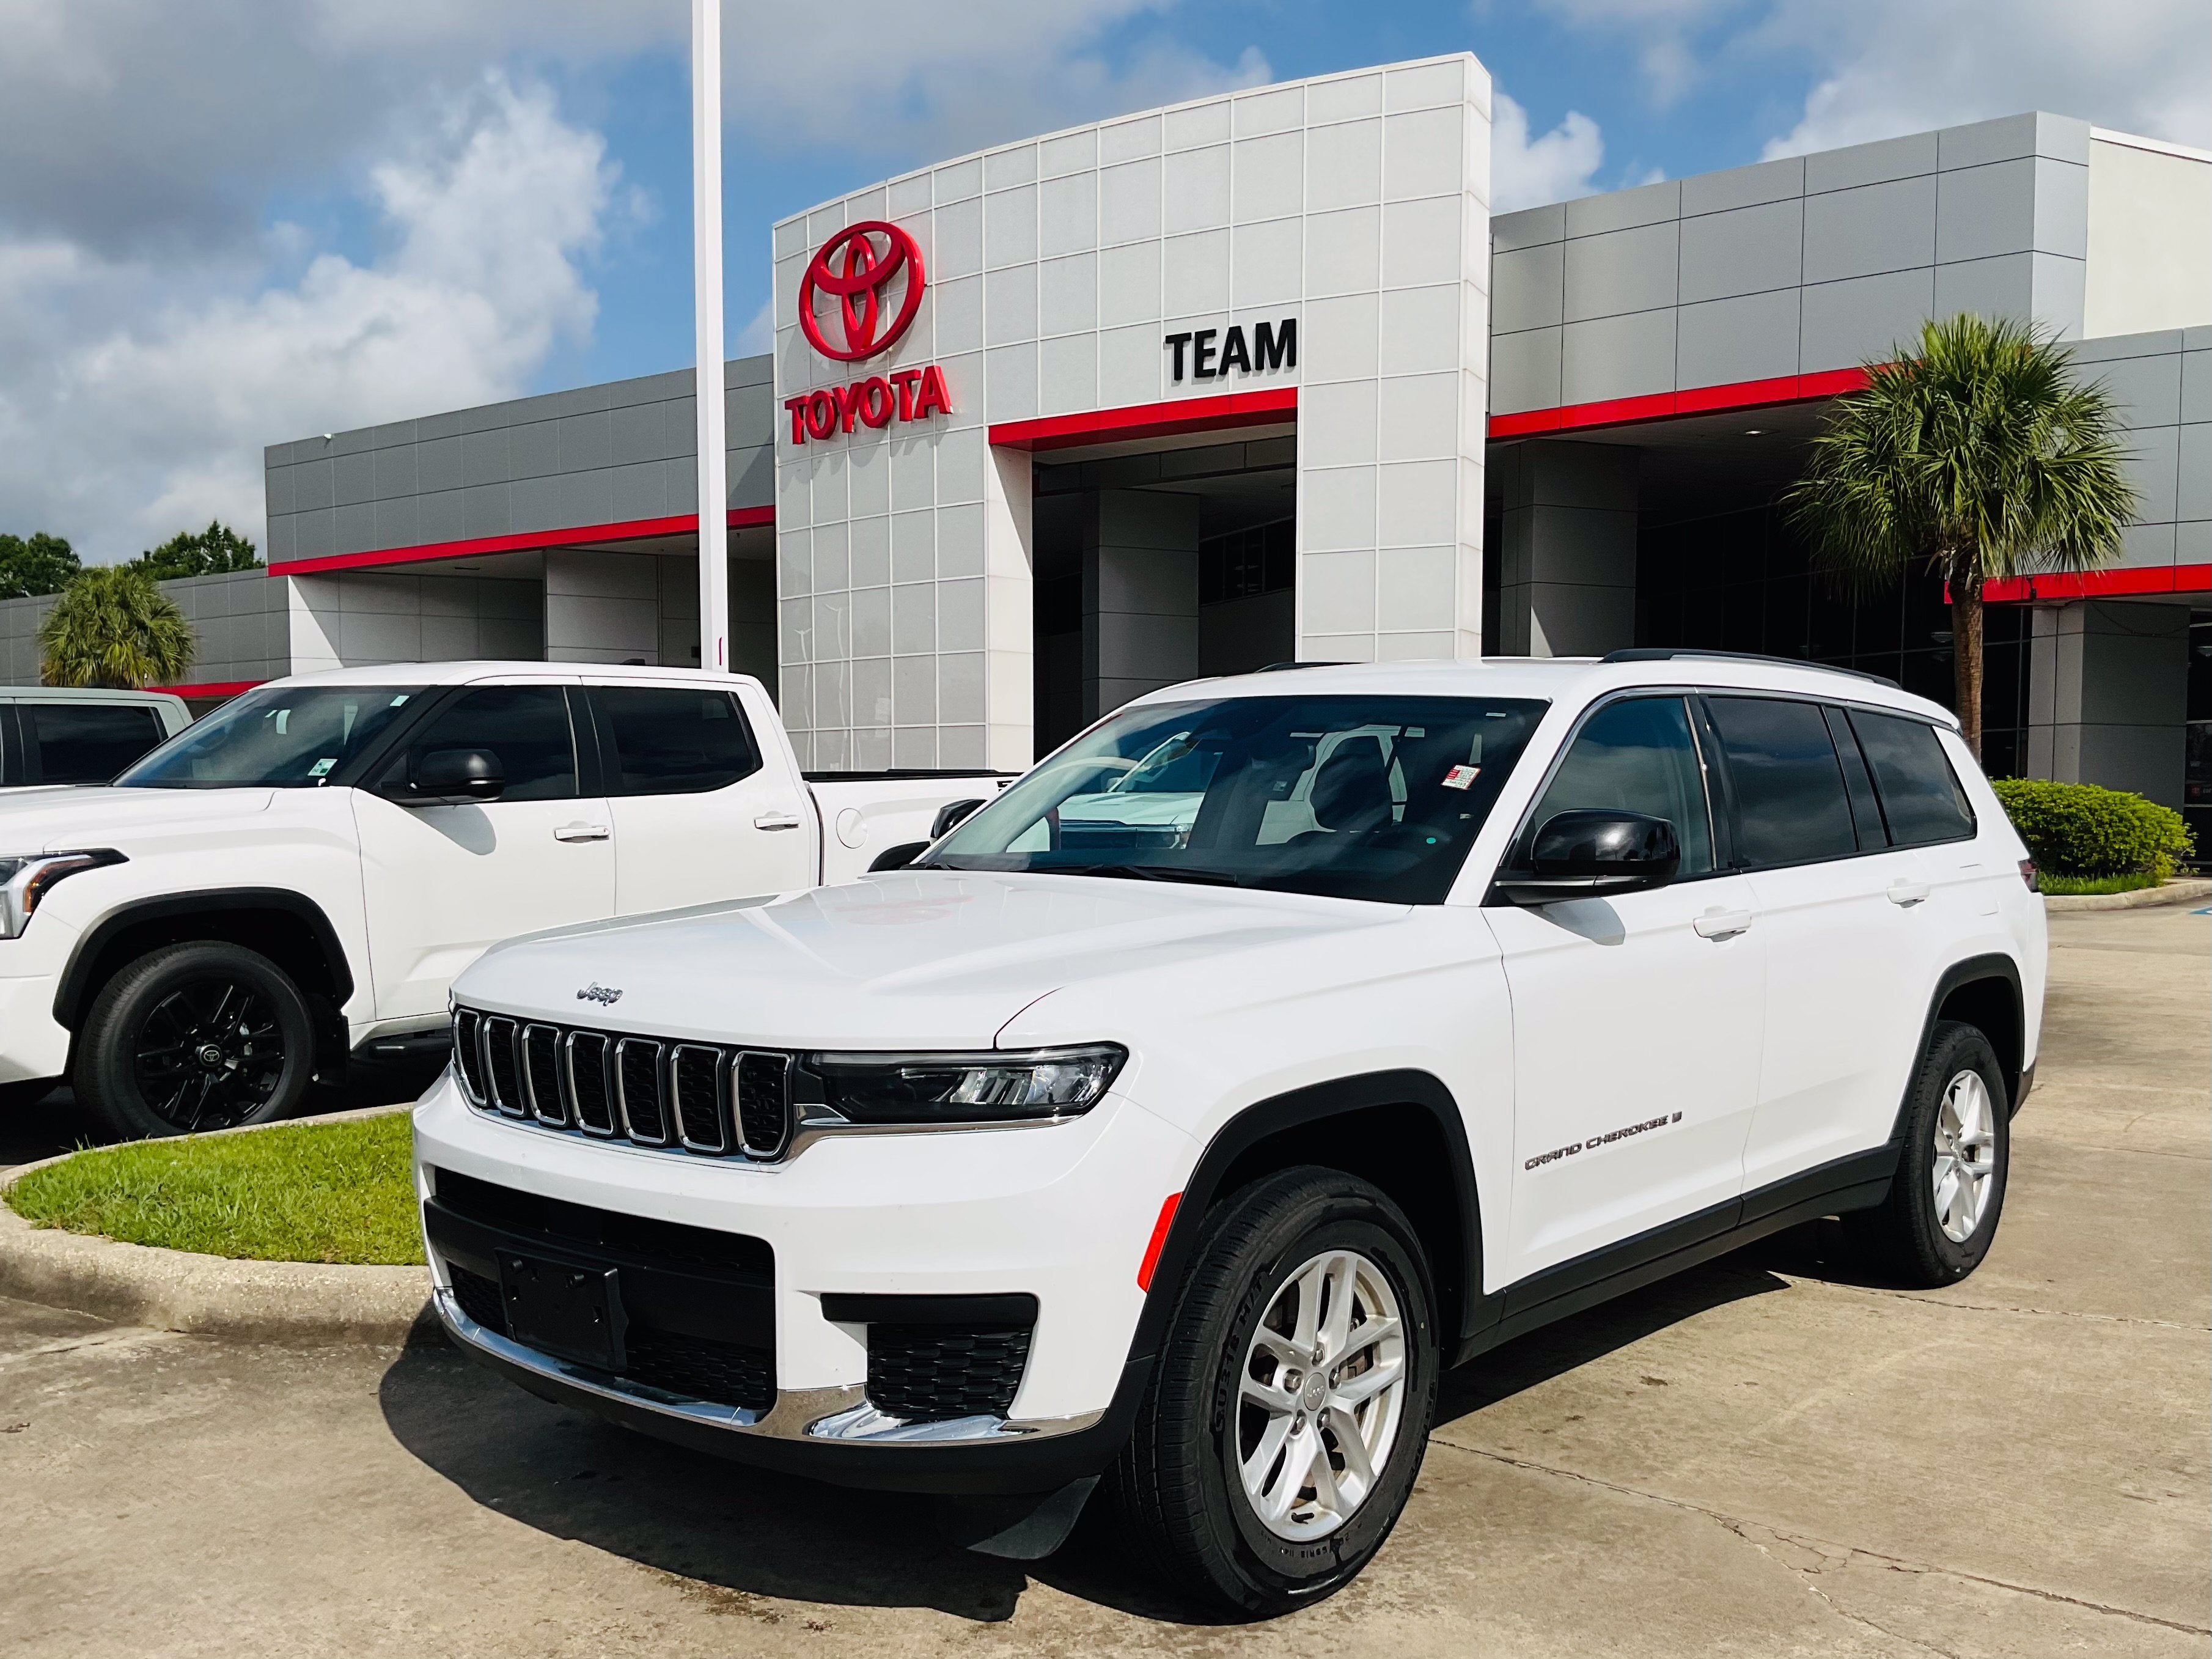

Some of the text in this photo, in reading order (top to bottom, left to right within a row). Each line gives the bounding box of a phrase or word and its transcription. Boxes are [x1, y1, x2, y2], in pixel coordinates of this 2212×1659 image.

[1165, 318, 1297, 380] TEAM
[784, 365, 952, 445] TOYOTA
[576, 981, 623, 1006] Jeep
[1524, 1114, 1669, 1171] GRAND CHEROKEE
